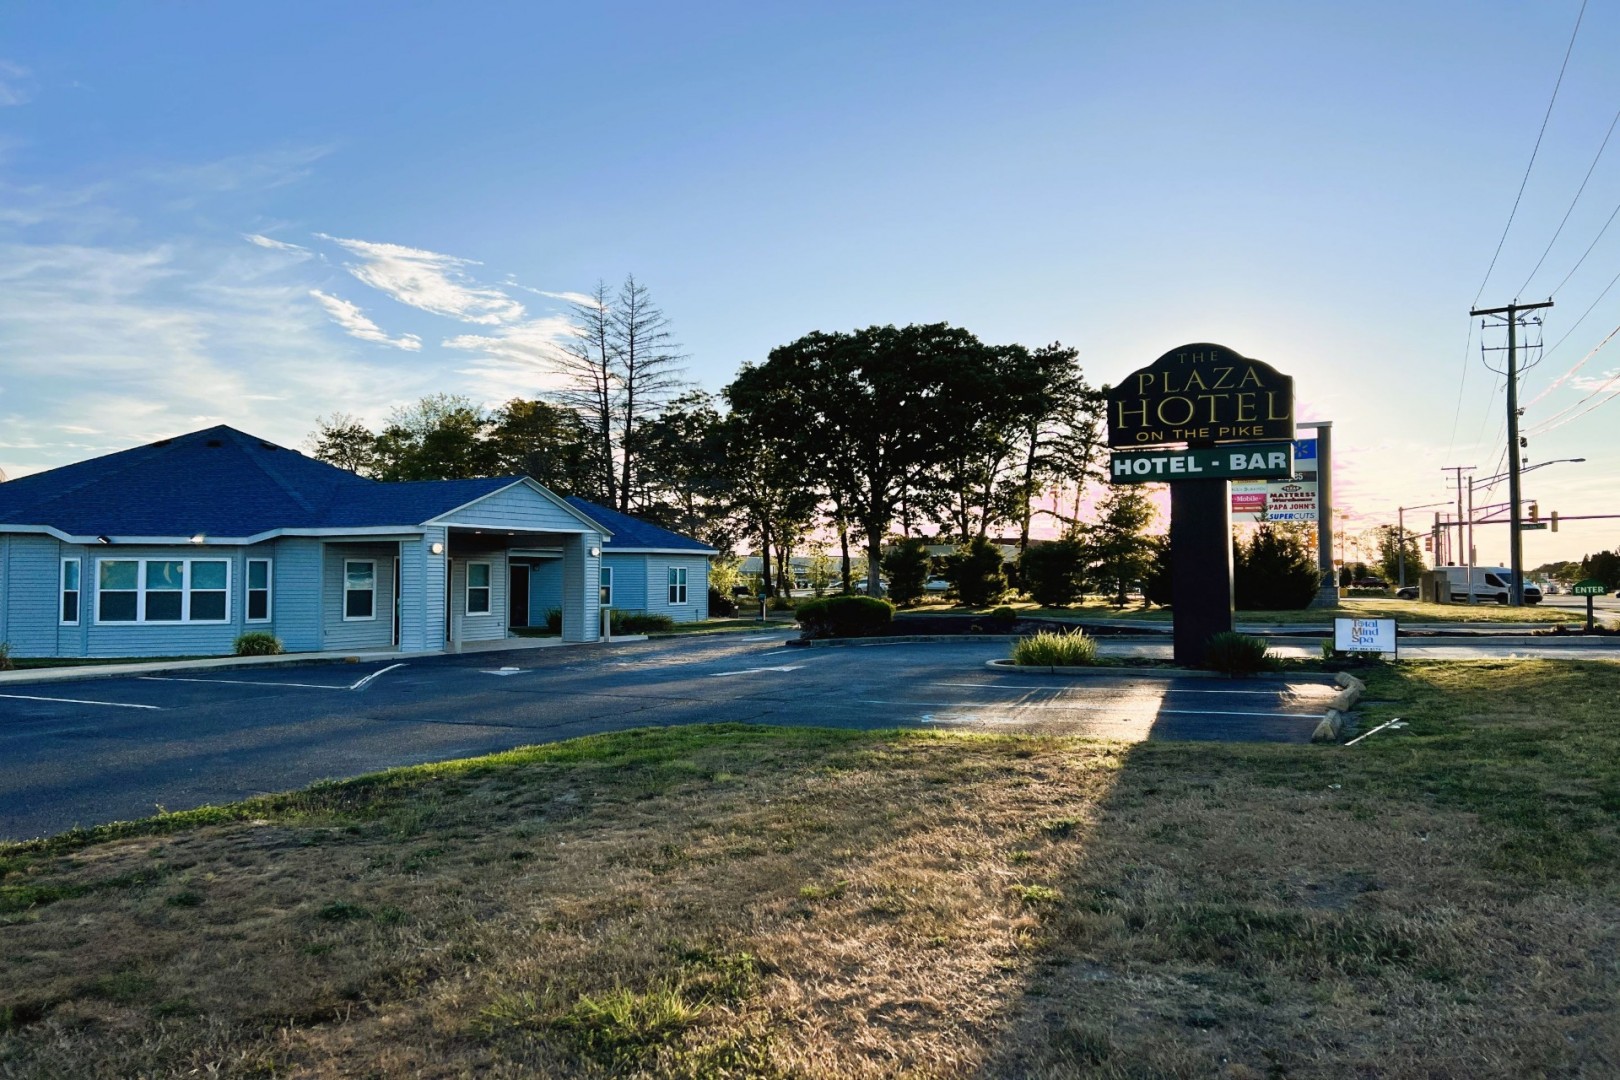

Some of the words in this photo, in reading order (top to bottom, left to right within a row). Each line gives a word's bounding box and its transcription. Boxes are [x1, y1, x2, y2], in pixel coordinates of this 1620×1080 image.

[1176, 350, 1219, 364] THE
[1138, 365, 1265, 395] PLAZA
[1115, 391, 1290, 429] HOTEL
[1136, 430, 1163, 442] ON
[1172, 427, 1210, 439] THE
[1219, 425, 1264, 437] PIKE
[1114, 455, 1203, 476] HOTEL
[1229, 452, 1287, 471] BAR
[1575, 586, 1604, 594] ENTER
[1352, 619, 1378, 627] Total
[1352, 635, 1374, 644] Spa
